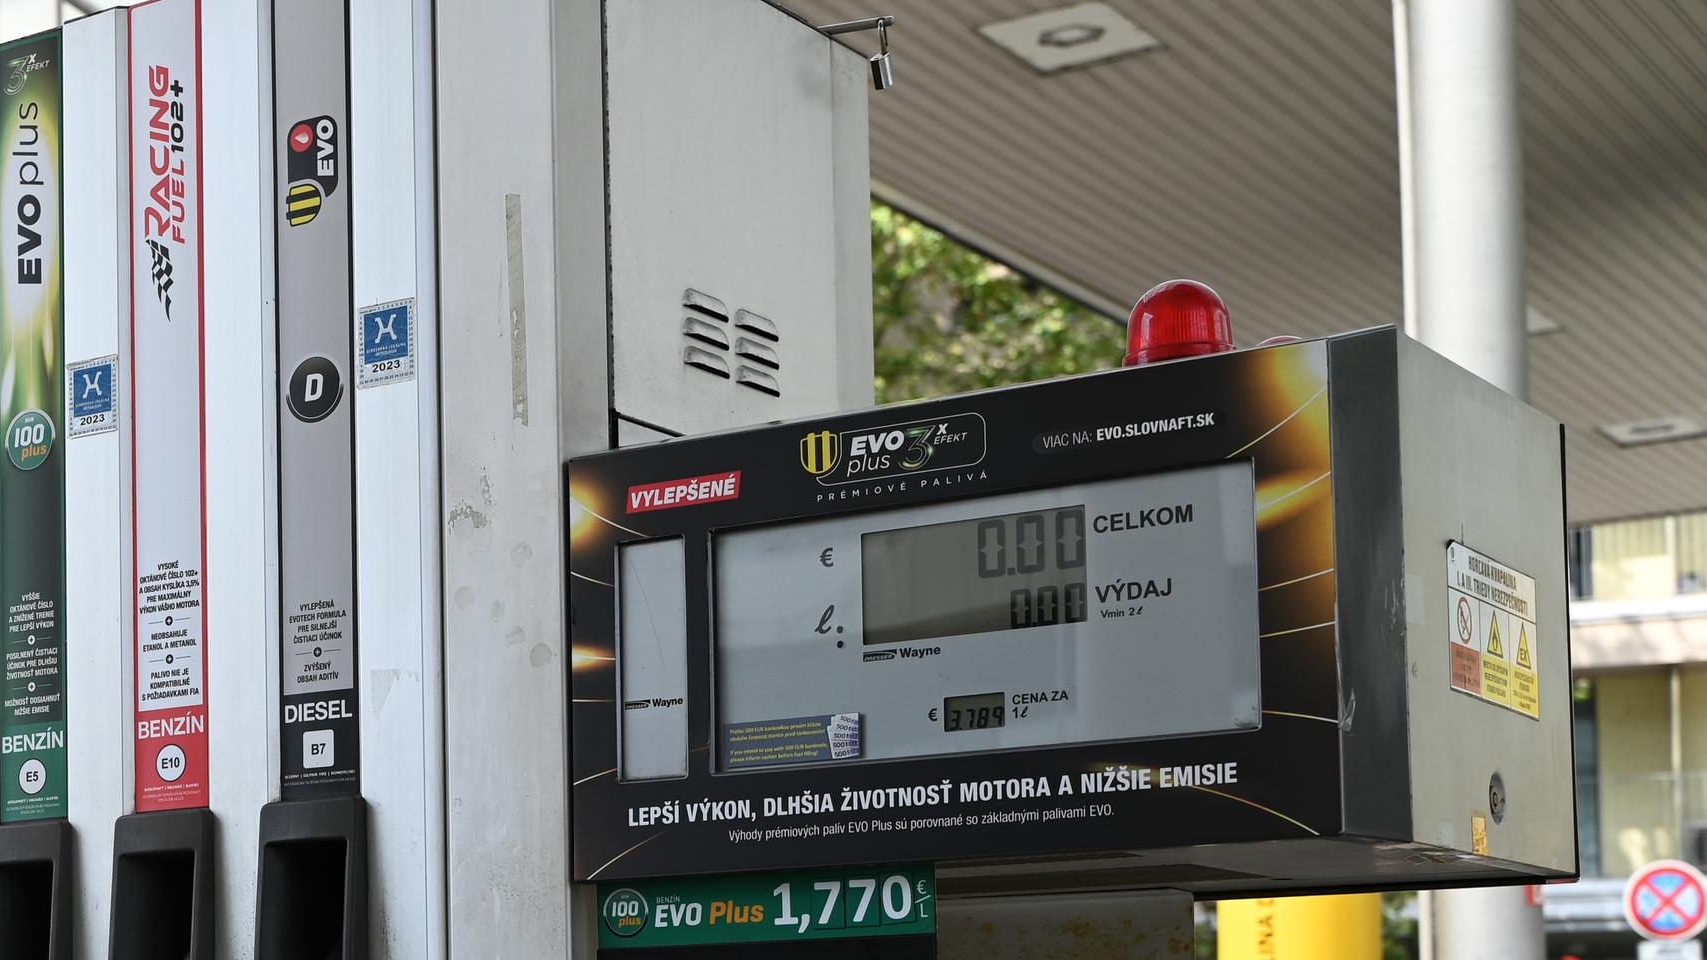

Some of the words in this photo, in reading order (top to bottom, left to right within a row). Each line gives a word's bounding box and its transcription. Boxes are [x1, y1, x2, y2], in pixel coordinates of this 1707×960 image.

[26, 60, 50, 72] EFEKT
[4, 55, 29, 95] 3
[170, 79, 184, 153] 102+
[12, 101, 44, 186] plus
[317, 119, 334, 177] EVO
[145, 65, 171, 238] RACING
[172, 159, 186, 244] FUEL
[17, 194, 43, 285] EVO
[372, 360, 401, 373] 2023
[304, 373, 323, 402] D
[80, 414, 105, 426] 2023
[15, 423, 44, 448] 100
[1043, 433, 1069, 449] VIAC
[1072, 431, 1092, 446] NA:
[1096, 412, 1215, 441] EVO.SLOVNAFT.SK
[934, 431, 968, 446] EFEKT
[21, 444, 47, 462] plus
[850, 431, 905, 456] EVO
[898, 425, 935, 470] 3
[847, 451, 890, 476] plus
[631, 474, 736, 509] VYLEPŠENÉ
[817, 480, 907, 502] PRÉMIOVÉ
[921, 470, 987, 488] PALIVÁ
[819, 547, 834, 567] €
[978, 509, 1086, 579] 0.00
[1093, 504, 1194, 533] CELKOM
[157, 559, 179, 571] VYSOKÉ
[168, 570, 184, 580] ČÍSLO
[185, 569, 198, 578] 102+
[146, 594, 157, 603] PRE
[157, 590, 192, 602] MAXIMÁLNY
[1095, 578, 1172, 603] VÝDAJ
[157, 602, 175, 613] VÁŠHO
[176, 600, 200, 610] MOTORA
[300, 599, 335, 612] VYLEPŠENÁ
[289, 613, 316, 624] EVOTECH
[316, 610, 346, 621] FORMULA
[1101, 608, 1125, 618] Vmin
[9, 625, 19, 633] PRE
[297, 624, 310, 633] PRE
[310, 620, 337, 632] SILNEJŠÍ
[151, 629, 188, 641] NEOBSAHUJE
[293, 633, 318, 644] ČISTIACI
[319, 630, 343, 641] ÚČINOK
[142, 642, 163, 652] ETANOL
[170, 639, 197, 649] METANOL
[899, 647, 941, 659] Wayne
[304, 660, 331, 672] ZVÝŠENÝ
[150, 670, 169, 680] PALIVO
[170, 669, 181, 677] NIE
[181, 668, 189, 676] JE
[297, 674, 318, 684] OBSAH
[319, 671, 339, 682] ADITÍV
[150, 677, 190, 690] KOMPATIBILNÉ
[147, 689, 190, 701] POŽIADAVKAMI
[190, 688, 199, 696] FIA
[652, 698, 683, 707] Wayne
[284, 699, 353, 724] DIESEL
[928, 708, 938, 722] €
[950, 706, 1004, 731] 3.789
[1012, 692, 1048, 705] CENA
[1051, 690, 1068, 702] ZA
[138, 711, 204, 739] BENZÍN
[2, 727, 64, 754] BENZÍN
[311, 743, 326, 755] B7
[161, 756, 180, 769] E10
[26, 771, 39, 783] E5
[629, 803, 681, 827] LEPŠÍ
[689, 798, 756, 823] VÝKON,
[764, 789, 835, 818] DLHŠIA
[841, 779, 954, 812] ŽIVOTNOSŤ
[960, 775, 1050, 804] MOTORA
[1058, 775, 1073, 796] A
[1081, 765, 1151, 794] NIŽŠIE
[1159, 761, 1238, 789] EMISIE
[728, 828, 763, 844] Výhody
[765, 824, 820, 842] prémiových
[823, 822, 845, 838] palív
[848, 820, 868, 833] EVO
[870, 818, 893, 831] Plus
[895, 816, 907, 831] sú
[910, 813, 963, 831] porovnané
[966, 814, 979, 825] so
[981, 808, 1039, 827] základnými
[1043, 806, 1086, 821] palivami
[1090, 805, 1115, 818] EVO.
[612, 900, 639, 917] 100
[655, 903, 702, 928] EVO
[710, 900, 764, 925] Plus
[773, 875, 912, 934] 1,770
[656, 895, 680, 904] BENZÍN
[618, 916, 642, 928] plus
